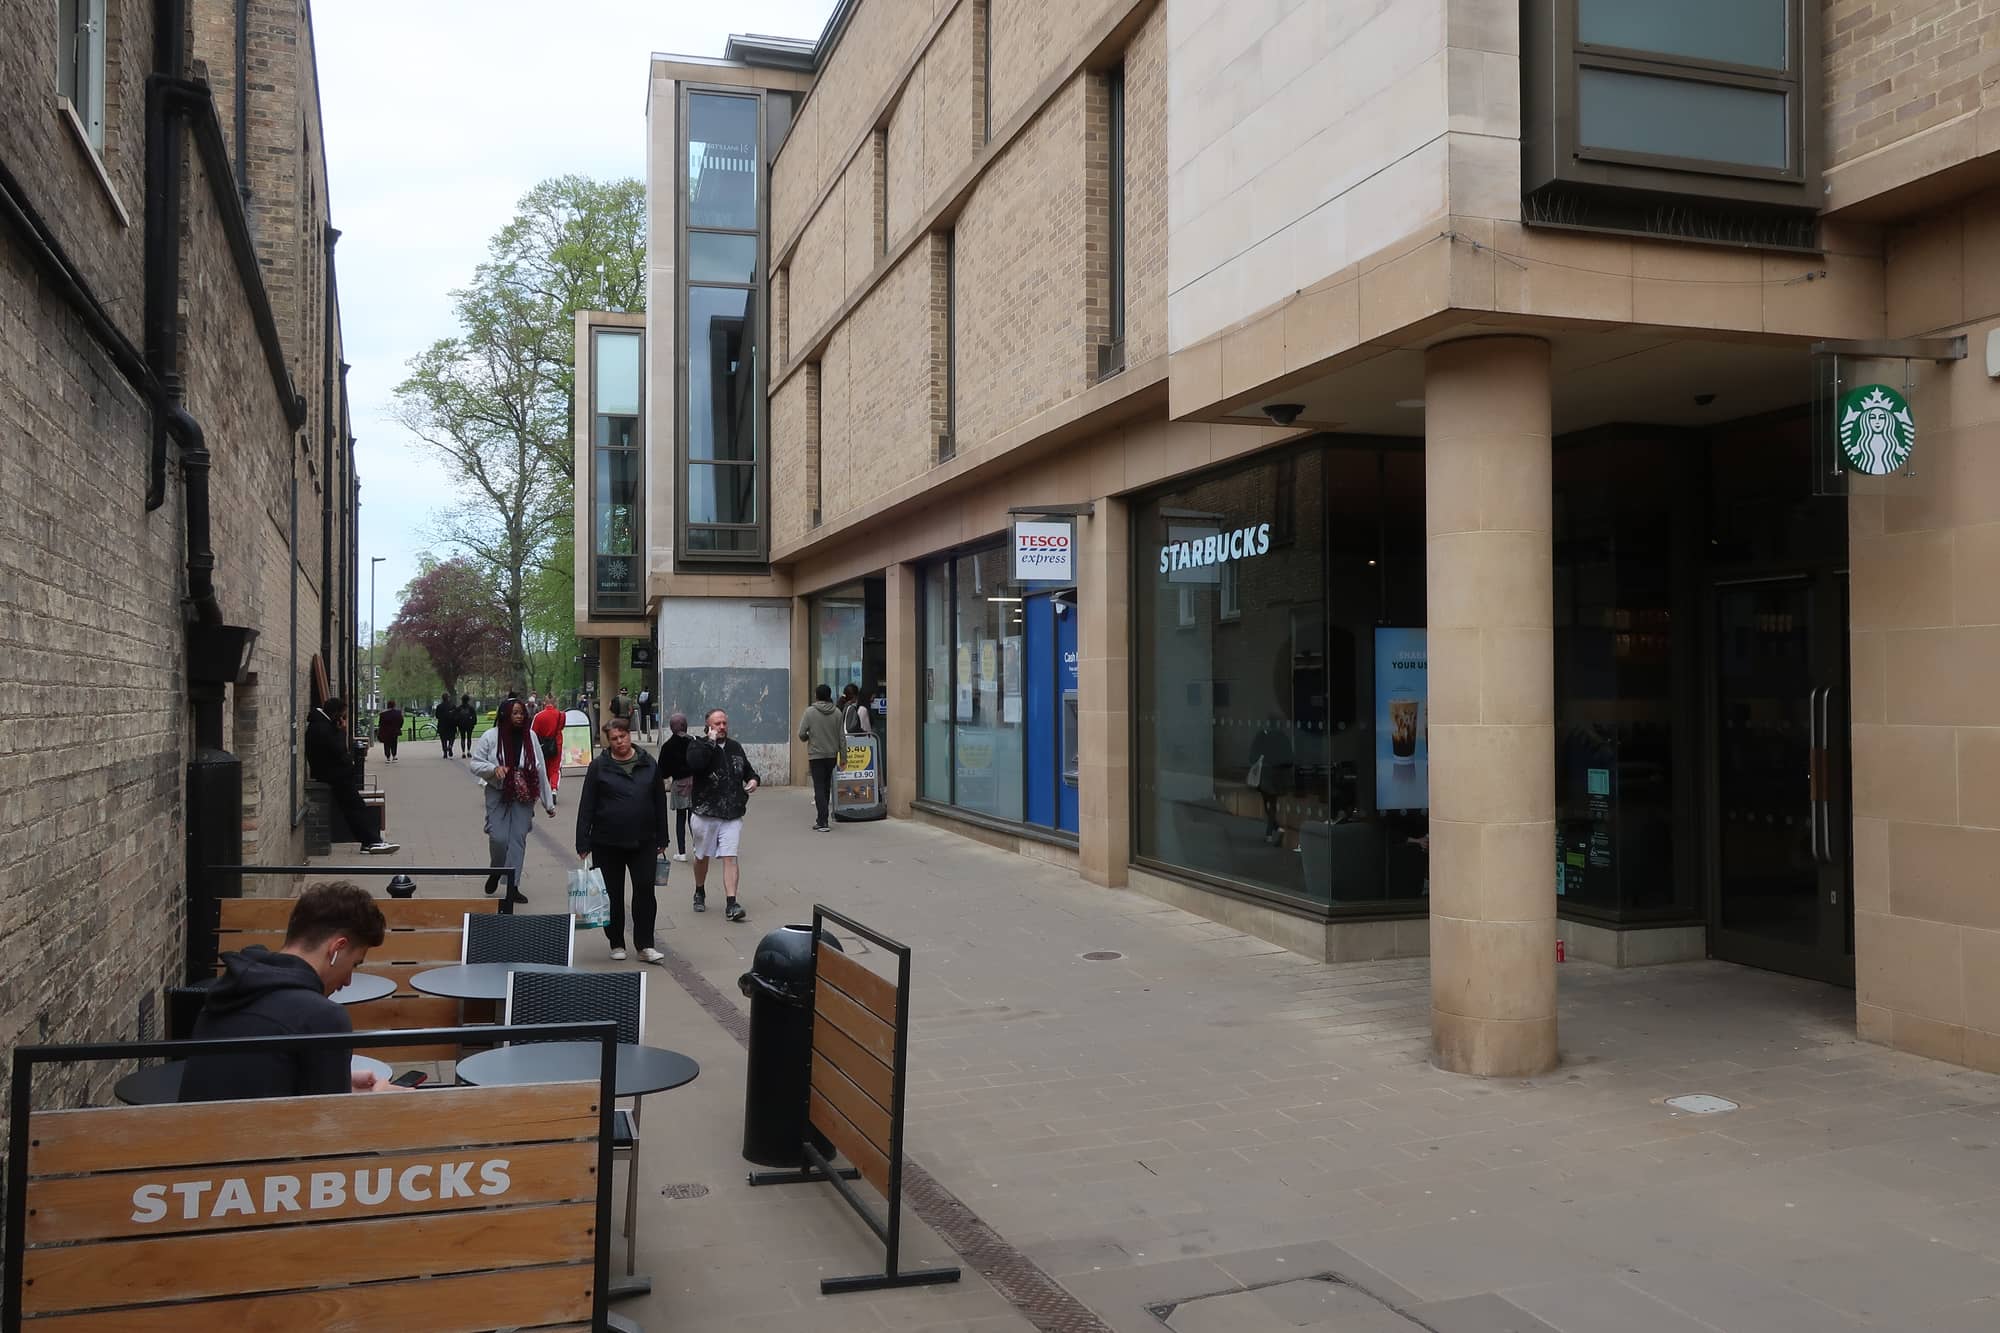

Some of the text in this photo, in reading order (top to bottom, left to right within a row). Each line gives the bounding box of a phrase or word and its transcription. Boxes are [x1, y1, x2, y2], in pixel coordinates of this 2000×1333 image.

[1019, 535, 1069, 547] TESCO
[1160, 523, 1270, 573] STARBUCKS
[1021, 554, 1067, 566] express
[1064, 651, 1076, 663] Cash
[1392, 661, 1416, 670] YOUR
[131, 1158, 512, 1223] STARBUCKS
